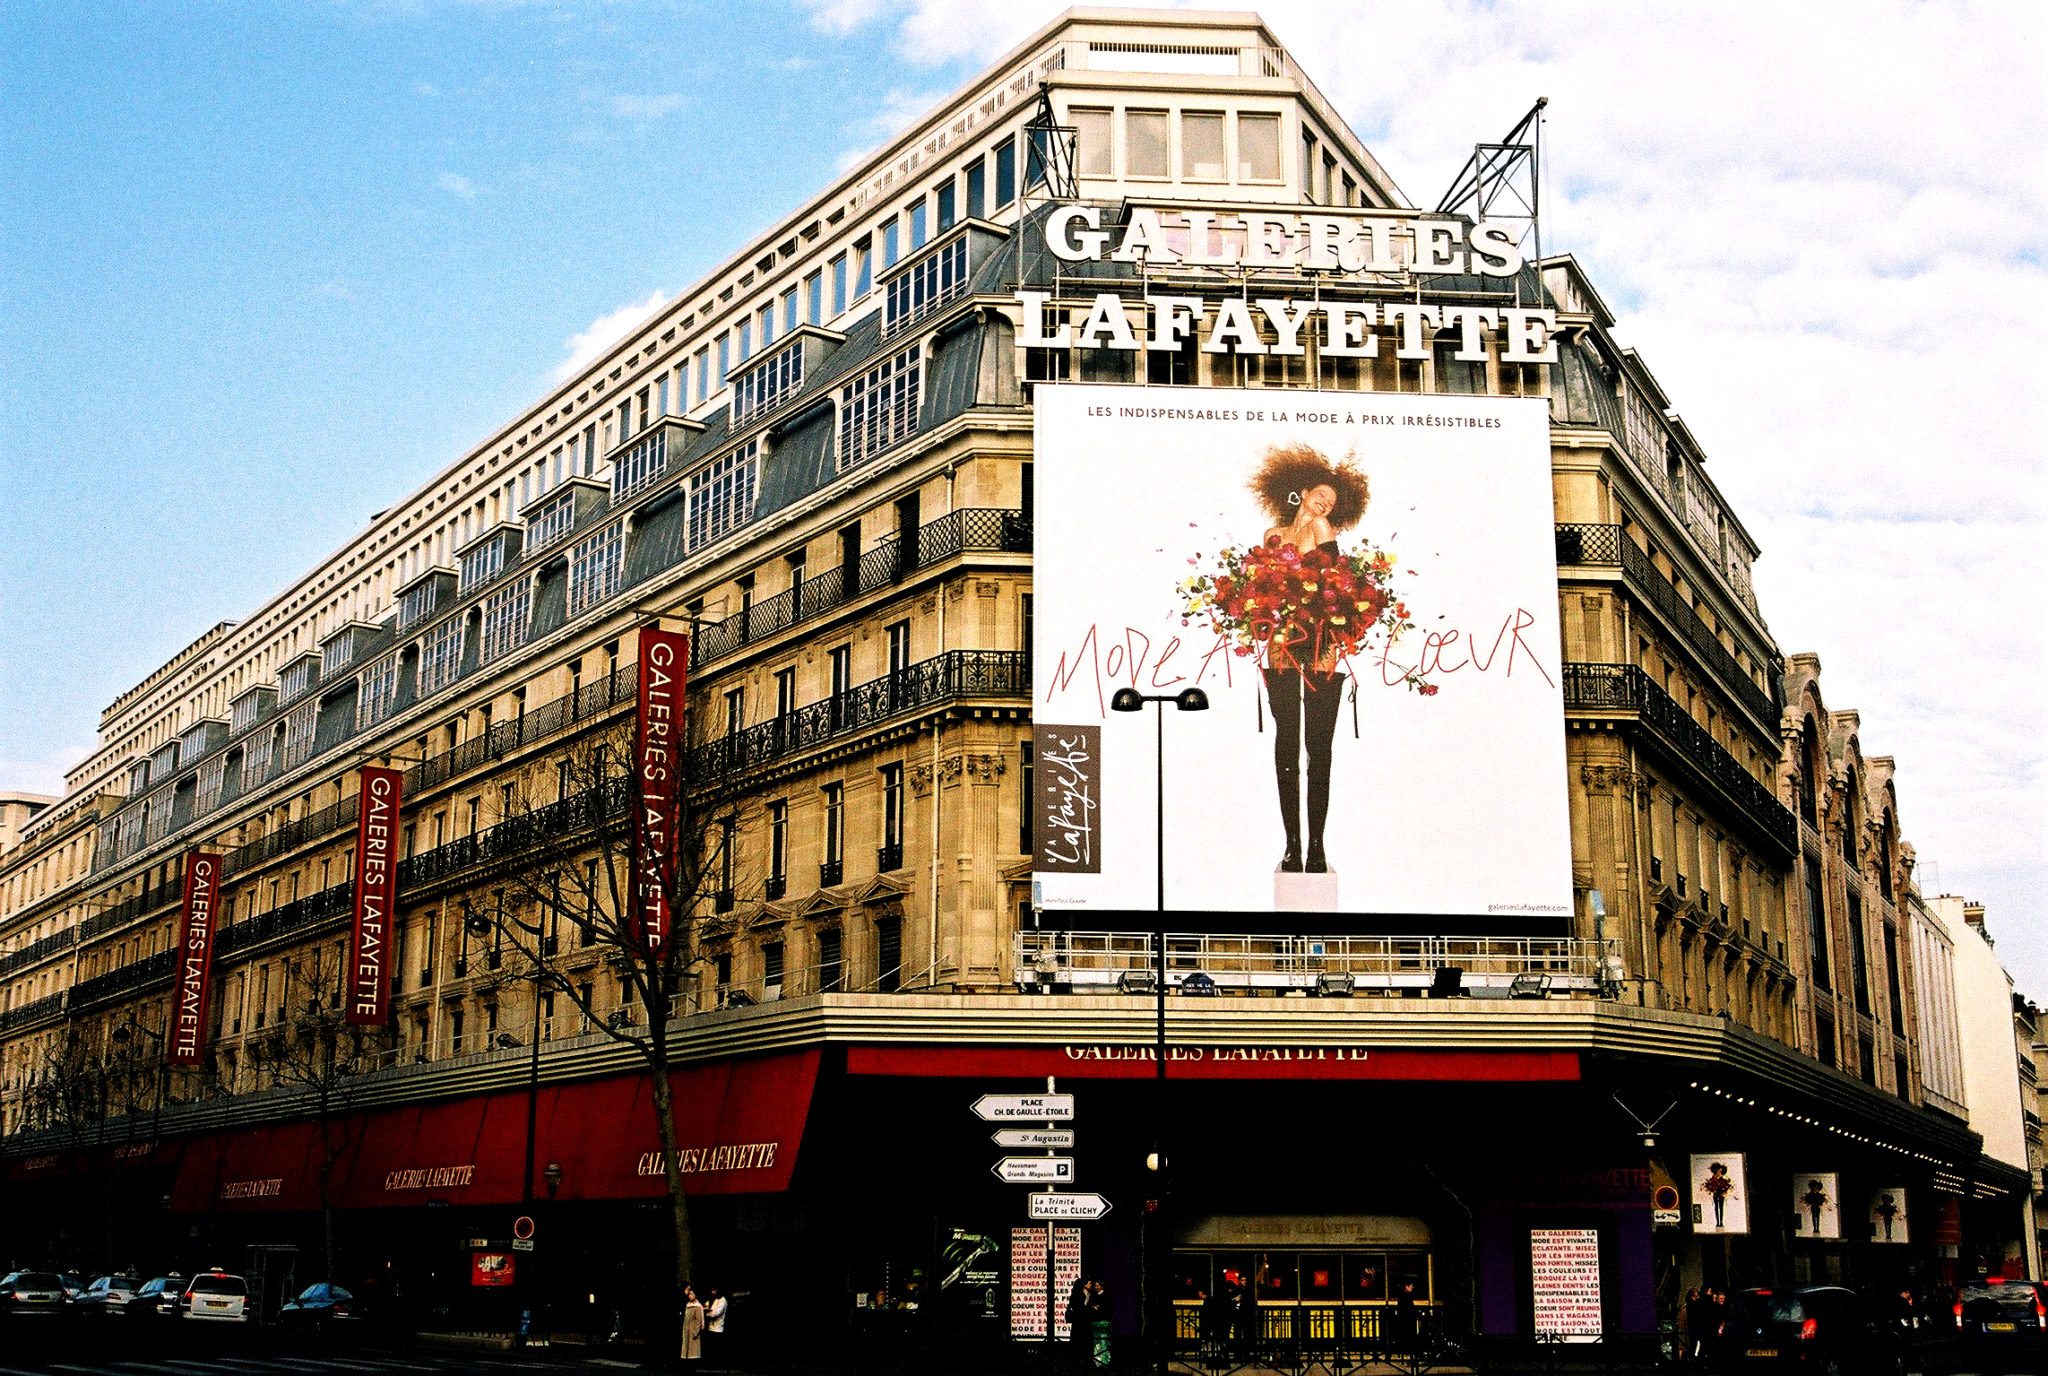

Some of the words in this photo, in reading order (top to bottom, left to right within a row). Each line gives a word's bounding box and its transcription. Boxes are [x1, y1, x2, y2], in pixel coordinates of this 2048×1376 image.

[1045, 206, 1523, 277] GALERIES
[1015, 290, 1558, 364] LAFAYETTE
[1088, 406, 1112, 417] LES
[1119, 407, 1239, 422] INDISPENSABLES
[1246, 410, 1265, 422] DE
[1272, 411, 1288, 422] LA
[1296, 412, 1338, 424] MODE
[1346, 410, 1354, 424] À
[1363, 414, 1395, 426] PRIX
[1402, 413, 1502, 428] IRRÉSISTIBLES
[1196, 633, 1232, 688] A
[365, 777, 390, 885] GALERIES
[1047, 733, 1058, 864] GALERIES
[188, 860, 212, 950] GALERIES
[356, 895, 383, 1016] LAFAYETTE
[178, 958, 204, 1057] LAFAYETTE
[638, 1149, 700, 1176] GALIES
[699, 1142, 778, 1172] LAFAYETTE
[1032, 1135, 1069, 1144] Augustin
